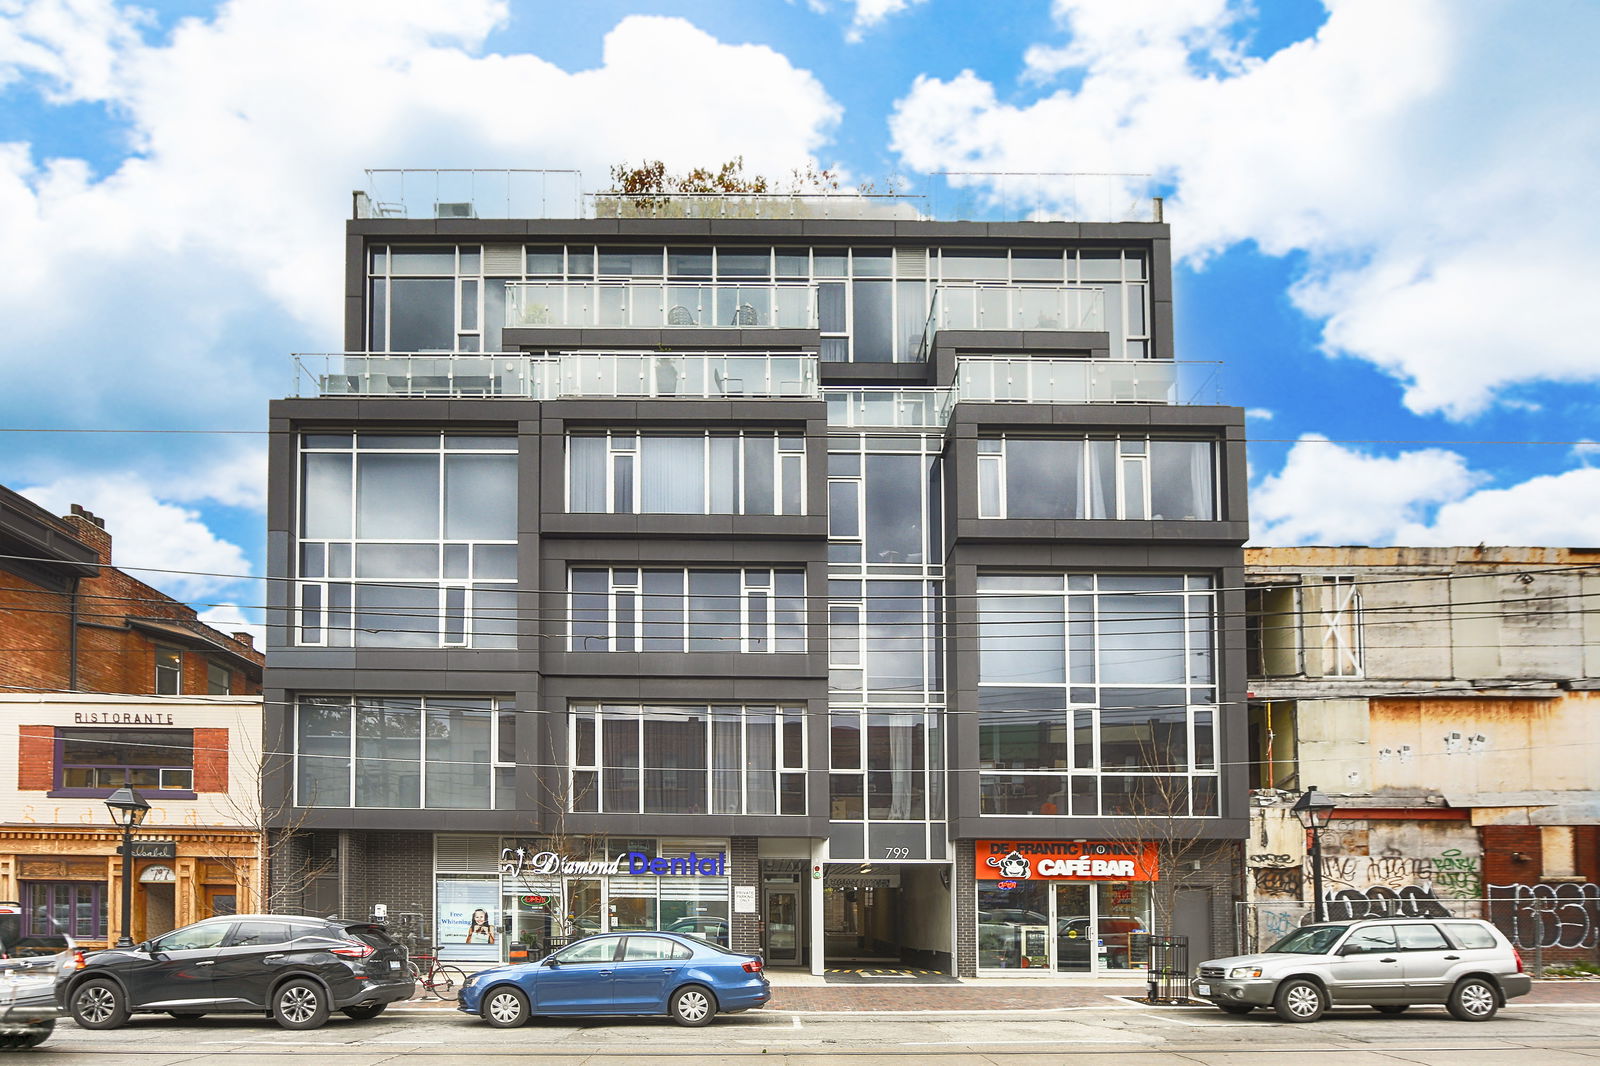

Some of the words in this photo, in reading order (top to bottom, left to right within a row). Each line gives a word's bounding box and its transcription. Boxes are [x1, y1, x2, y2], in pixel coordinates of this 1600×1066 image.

[75, 712, 173, 724] RISTORANTE
[885, 847, 910, 859] 799
[990, 843, 1009, 855] DE
[1016, 843, 1079, 855] FRANTIC
[531, 851, 626, 876] Diamond
[629, 851, 726, 876] Dental
[1037, 855, 1091, 876] CAFÉ
[1091, 859, 1135, 876] BAR
